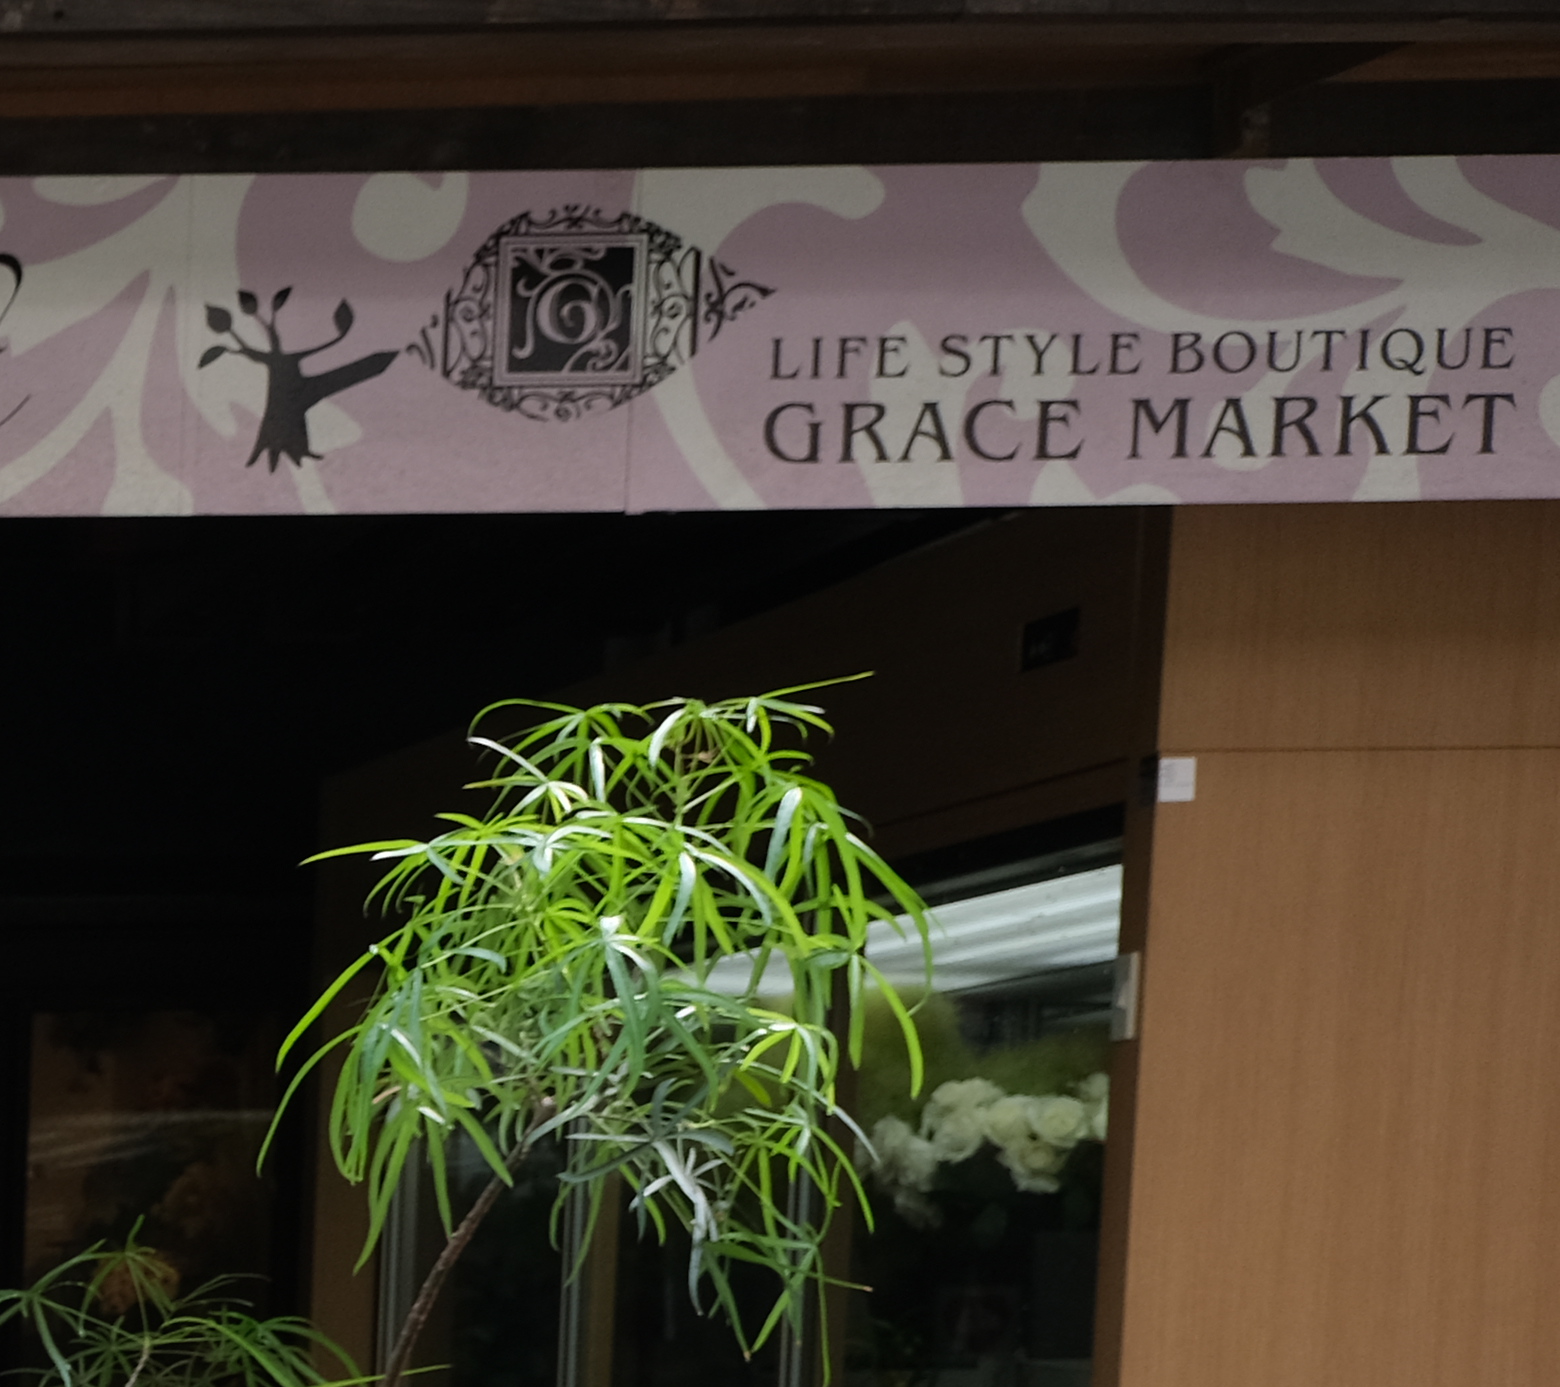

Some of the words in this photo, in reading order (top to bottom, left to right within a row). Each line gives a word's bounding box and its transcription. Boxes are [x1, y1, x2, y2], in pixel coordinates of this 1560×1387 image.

[770, 336, 910, 380] LIFE
[938, 331, 1141, 378] STYLE
[1169, 326, 1516, 376] BOUTIQUE
[764, 398, 1084, 463] GRACE
[1126, 392, 1516, 459] MARKET
